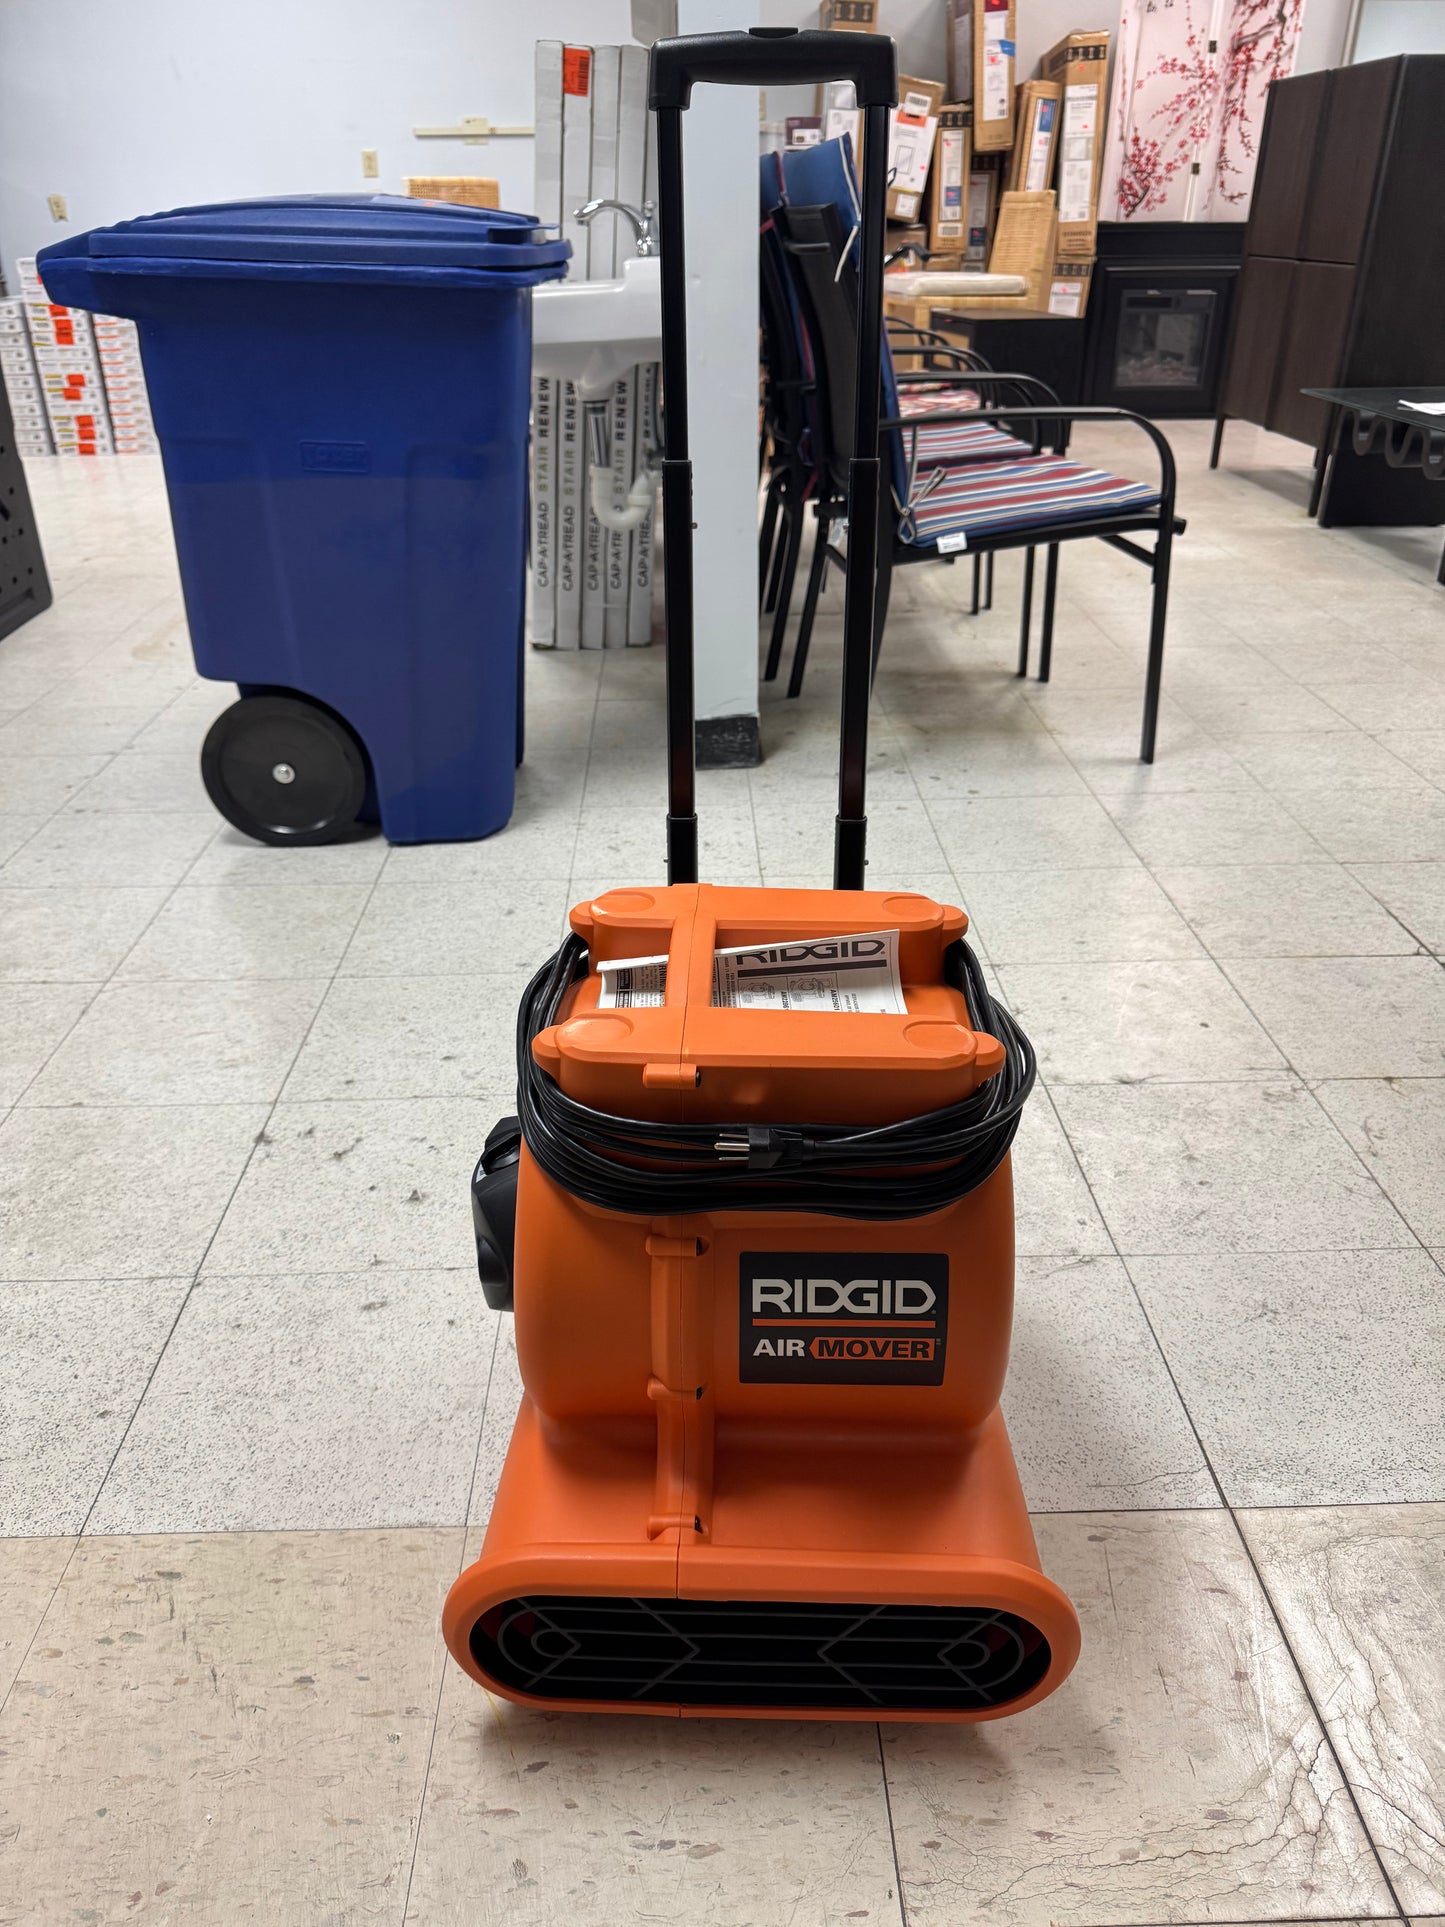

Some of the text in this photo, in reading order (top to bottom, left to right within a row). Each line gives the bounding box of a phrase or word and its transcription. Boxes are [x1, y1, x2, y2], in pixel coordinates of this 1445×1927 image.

[538, 378, 549, 438] RENEW
[565, 382, 576, 442] RENEW
[615, 381, 626, 441] RENEW
[537, 446, 548, 492] STAIR
[563, 449, 575, 496] STAIR
[613, 449, 625, 494] STAIR
[736, 939, 886, 965] RIDGID
[752, 1278, 936, 1315] RIDGID
[752, 1338, 930, 1359] AIR MOVER
